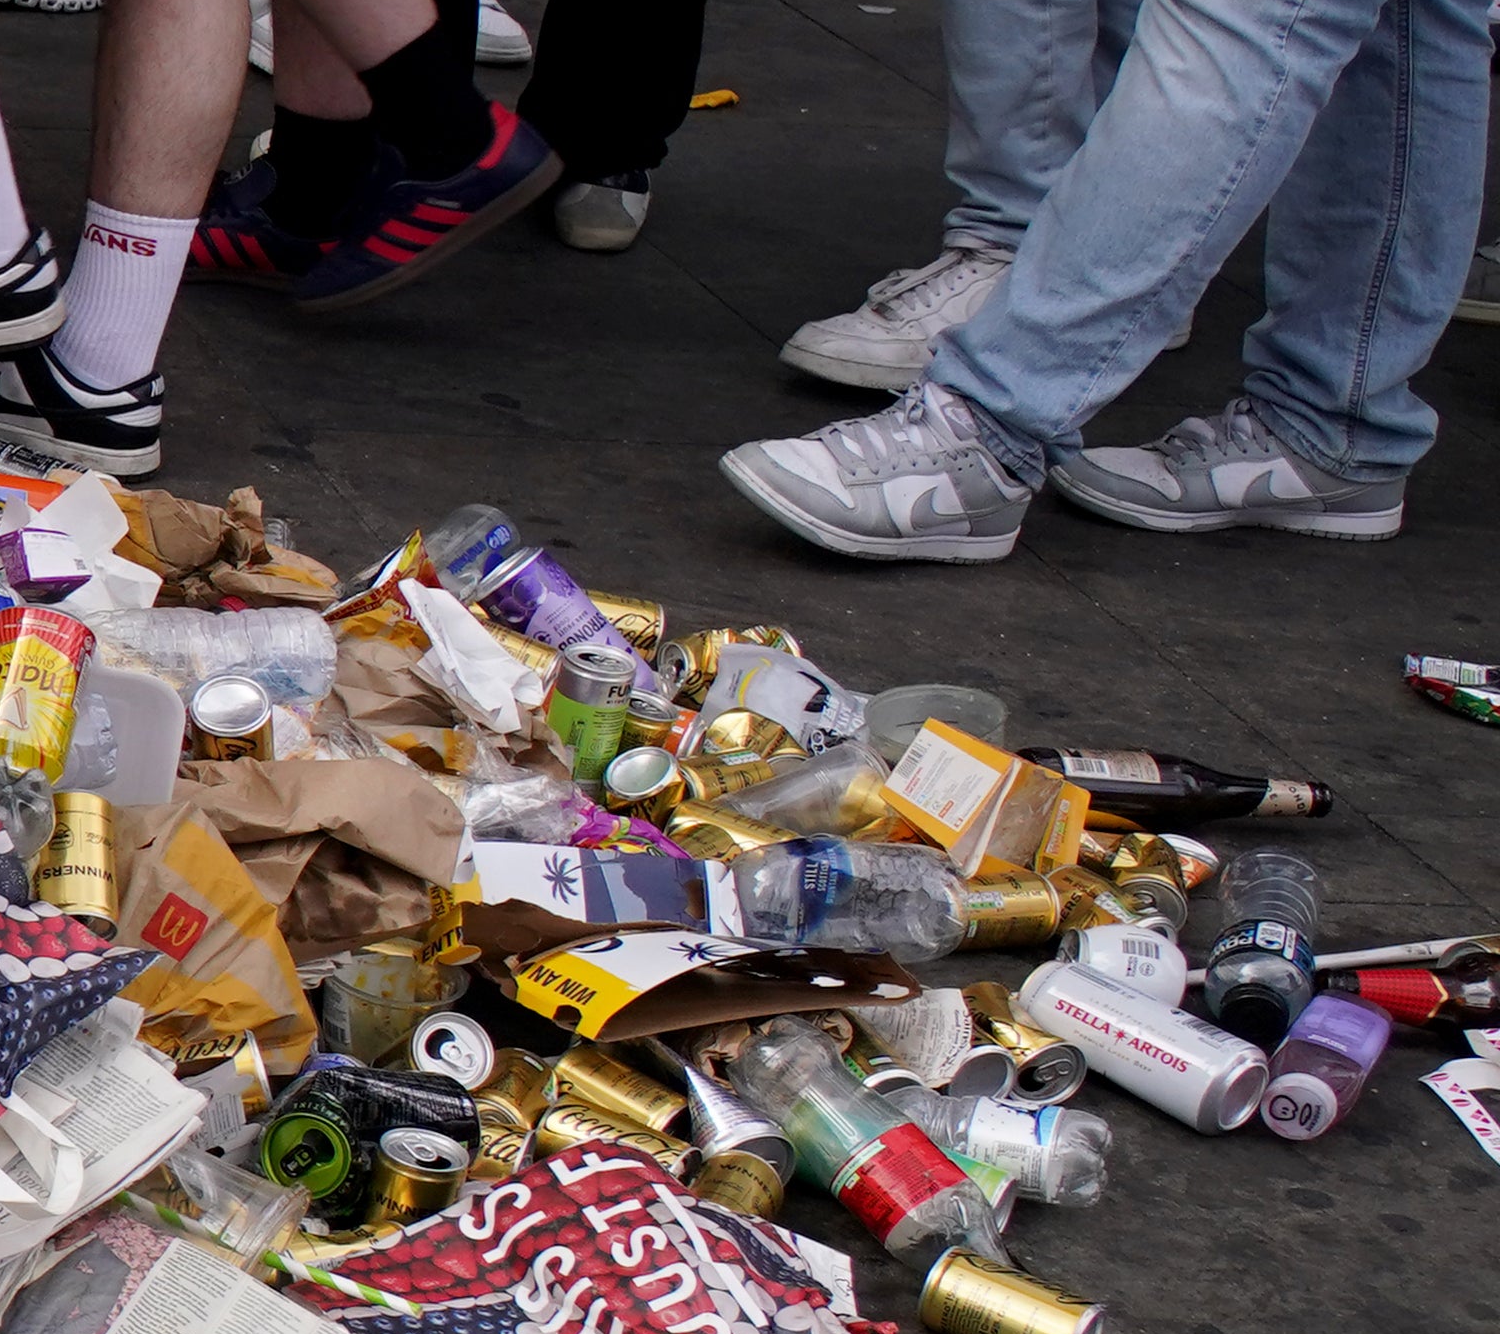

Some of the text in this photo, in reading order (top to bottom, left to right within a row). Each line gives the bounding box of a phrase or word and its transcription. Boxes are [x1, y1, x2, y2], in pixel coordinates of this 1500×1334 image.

[43, 865, 114, 884] WINNERS
[805, 863, 819, 889] STILL
[1055, 998, 1189, 1074] STELLA ARTOIS
